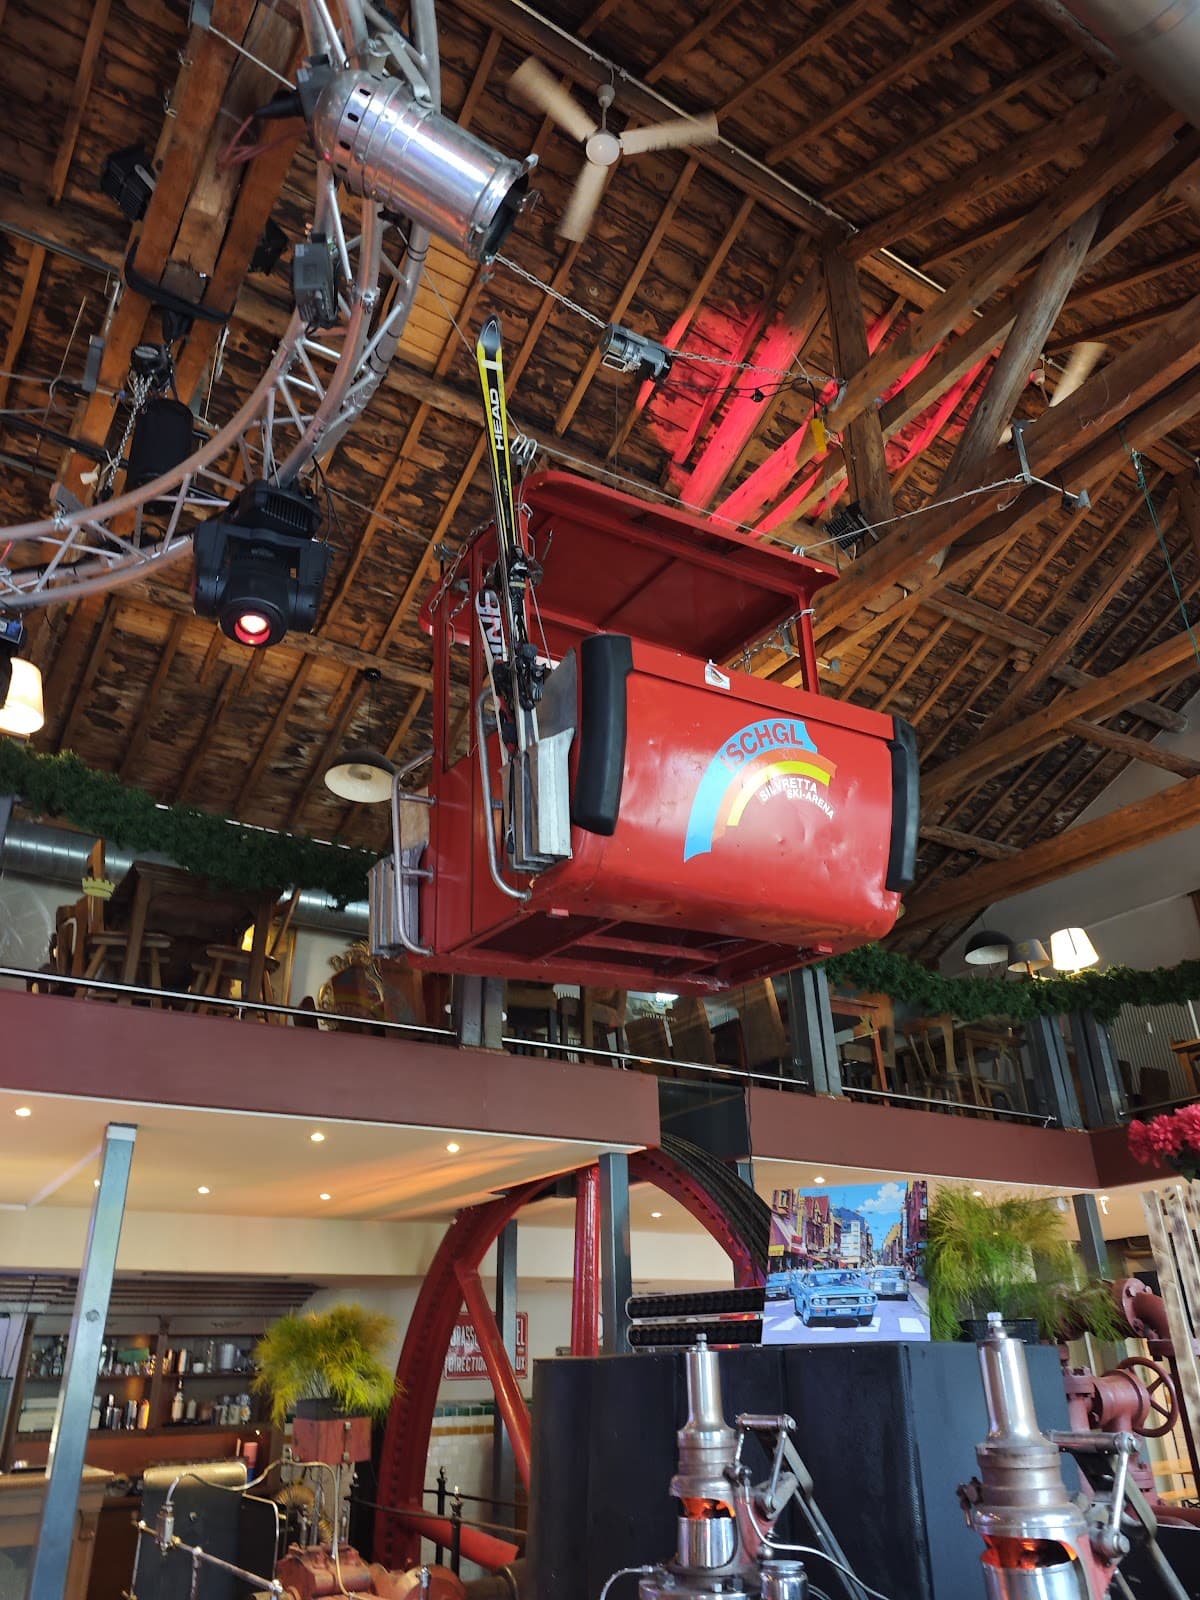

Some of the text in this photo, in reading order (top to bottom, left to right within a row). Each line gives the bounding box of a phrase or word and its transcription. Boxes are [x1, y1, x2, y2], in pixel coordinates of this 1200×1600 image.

[489, 388, 505, 451] HEAD
[720, 723, 803, 772] ISCHGL
[760, 777, 817, 802] SILVRETTA
